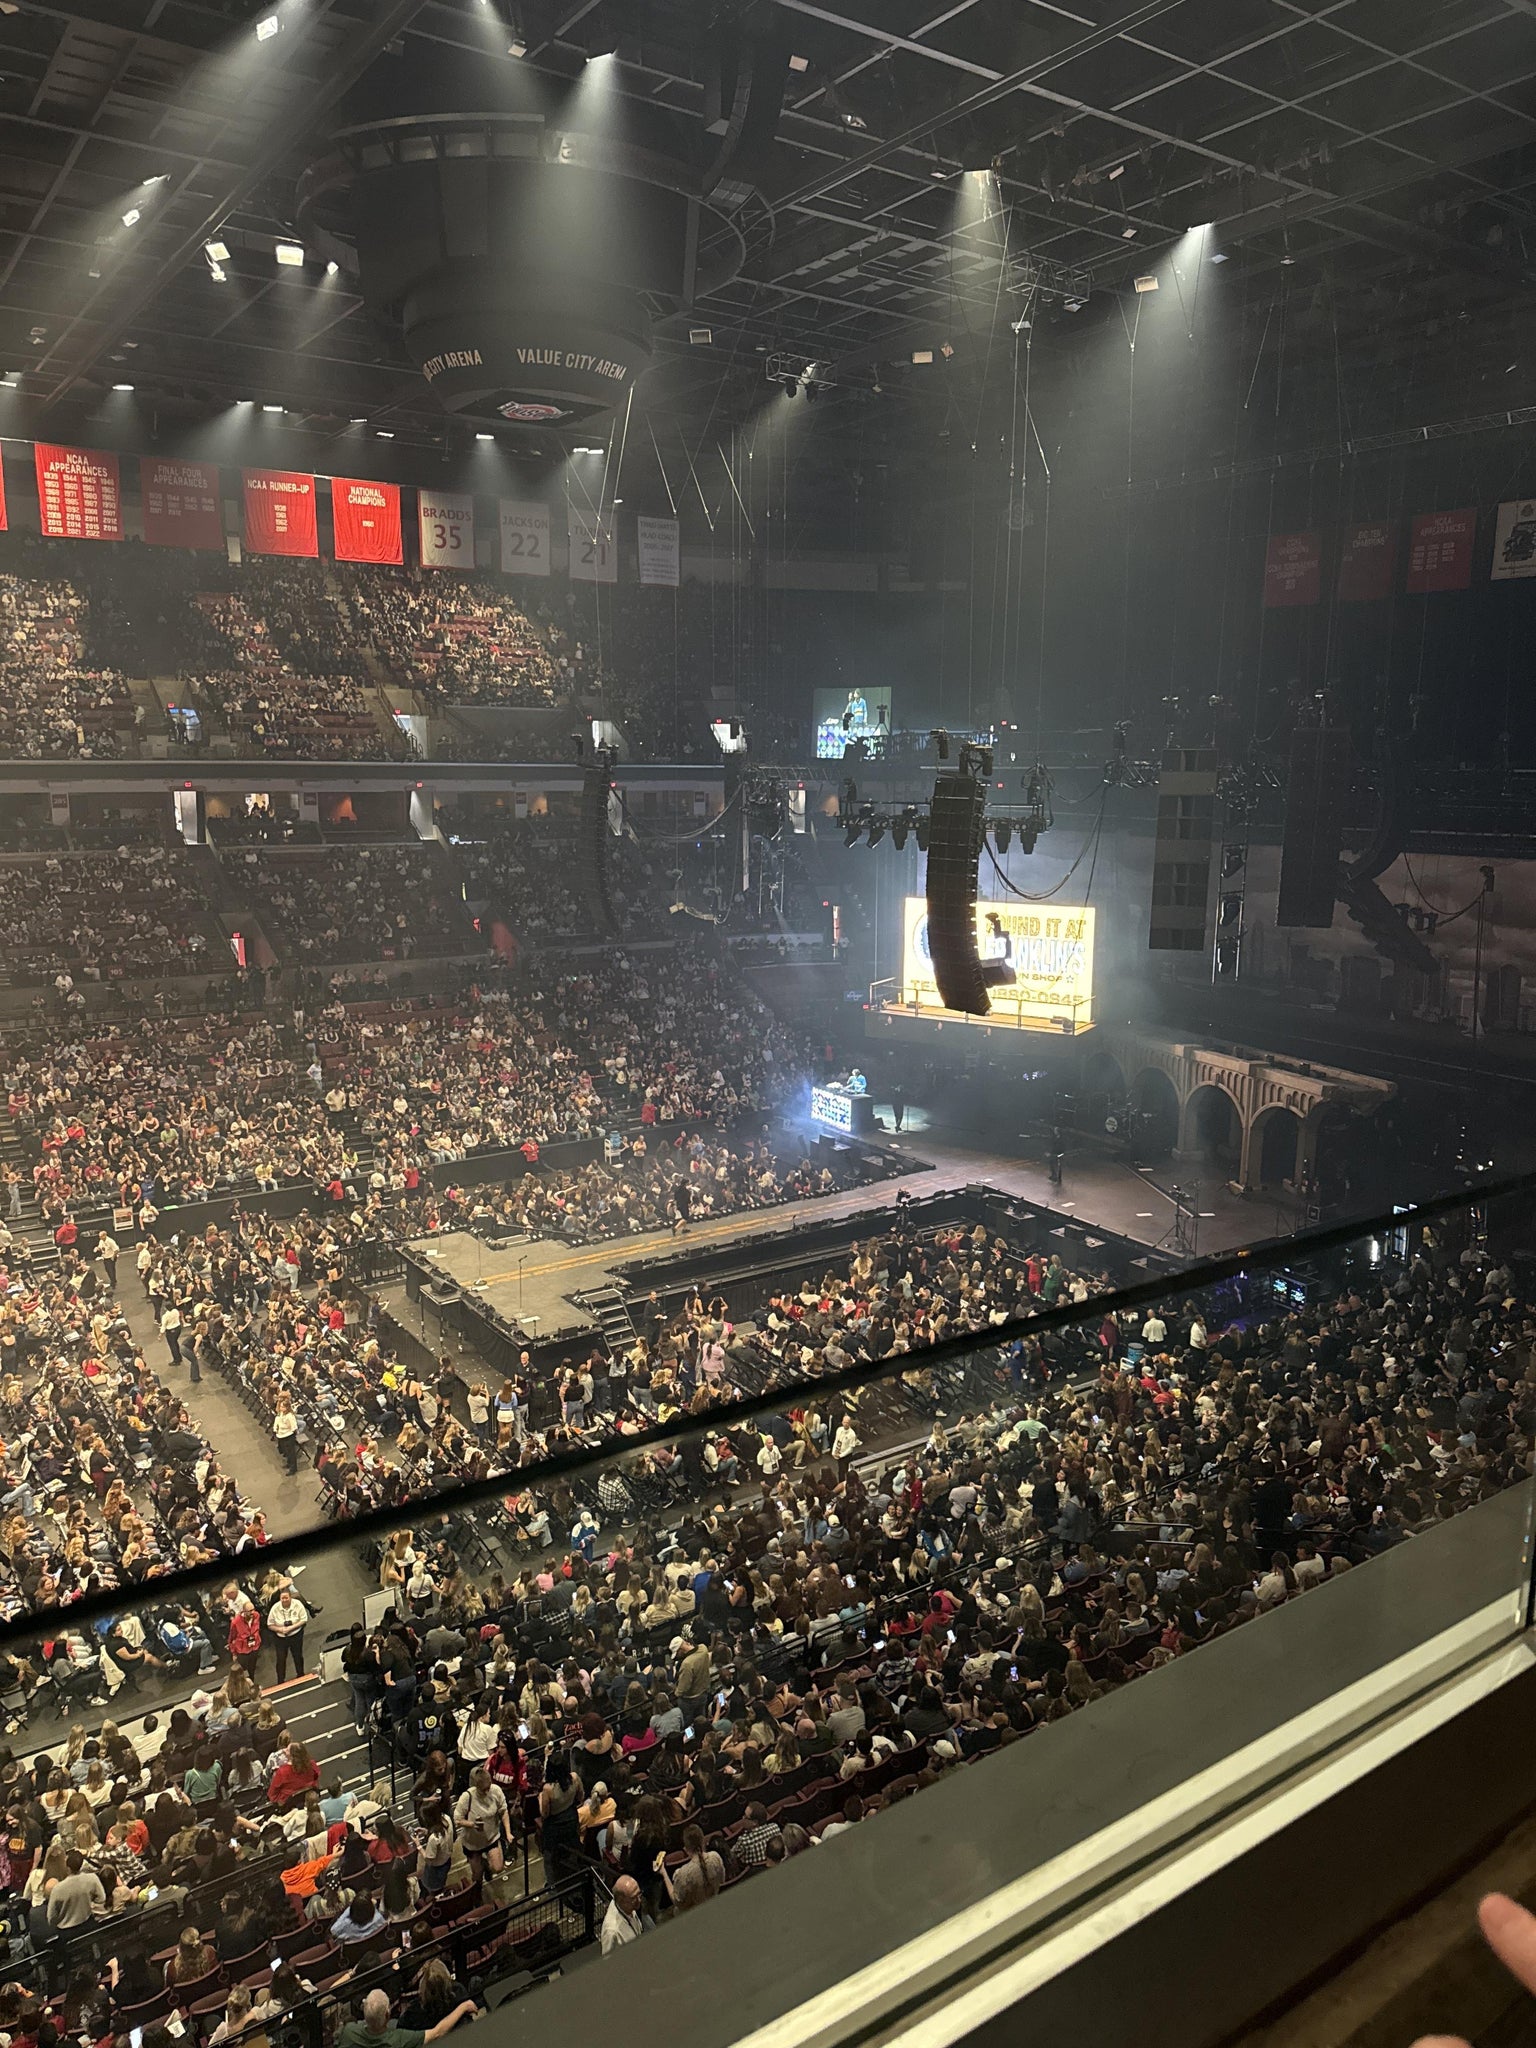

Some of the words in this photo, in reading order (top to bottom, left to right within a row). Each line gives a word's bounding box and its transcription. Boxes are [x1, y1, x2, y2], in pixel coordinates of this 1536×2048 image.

[428, 355, 446, 374] CITY
[444, 350, 482, 368] ARENA
[517, 349, 562, 366] VALUE
[566, 353, 596, 370] CITY
[595, 360, 627, 380] ARENA
[67, 454, 88, 465] NCAA
[50, 462, 108, 477] APPEARANCES
[158, 465, 178, 476] FINAL
[182, 468, 202, 478] FOUR
[154, 475, 208, 488] APPEARANCES
[248, 480, 267, 489] NCAA
[270, 482, 309, 493] RUNNER-UP
[351, 486, 382, 497] NATIONAL
[348, 496, 386, 507] CHAMPIONS
[423, 508, 471, 521] BRADDS
[503, 516, 548, 529] JACKSON
[434, 524, 462, 549] 35
[511, 533, 541, 558] 22
[581, 542, 606, 565] 21
[1046, 918, 1061, 938] IT
[1065, 919, 1087, 940] AT
[1032, 974, 1062, 982] SHOP
